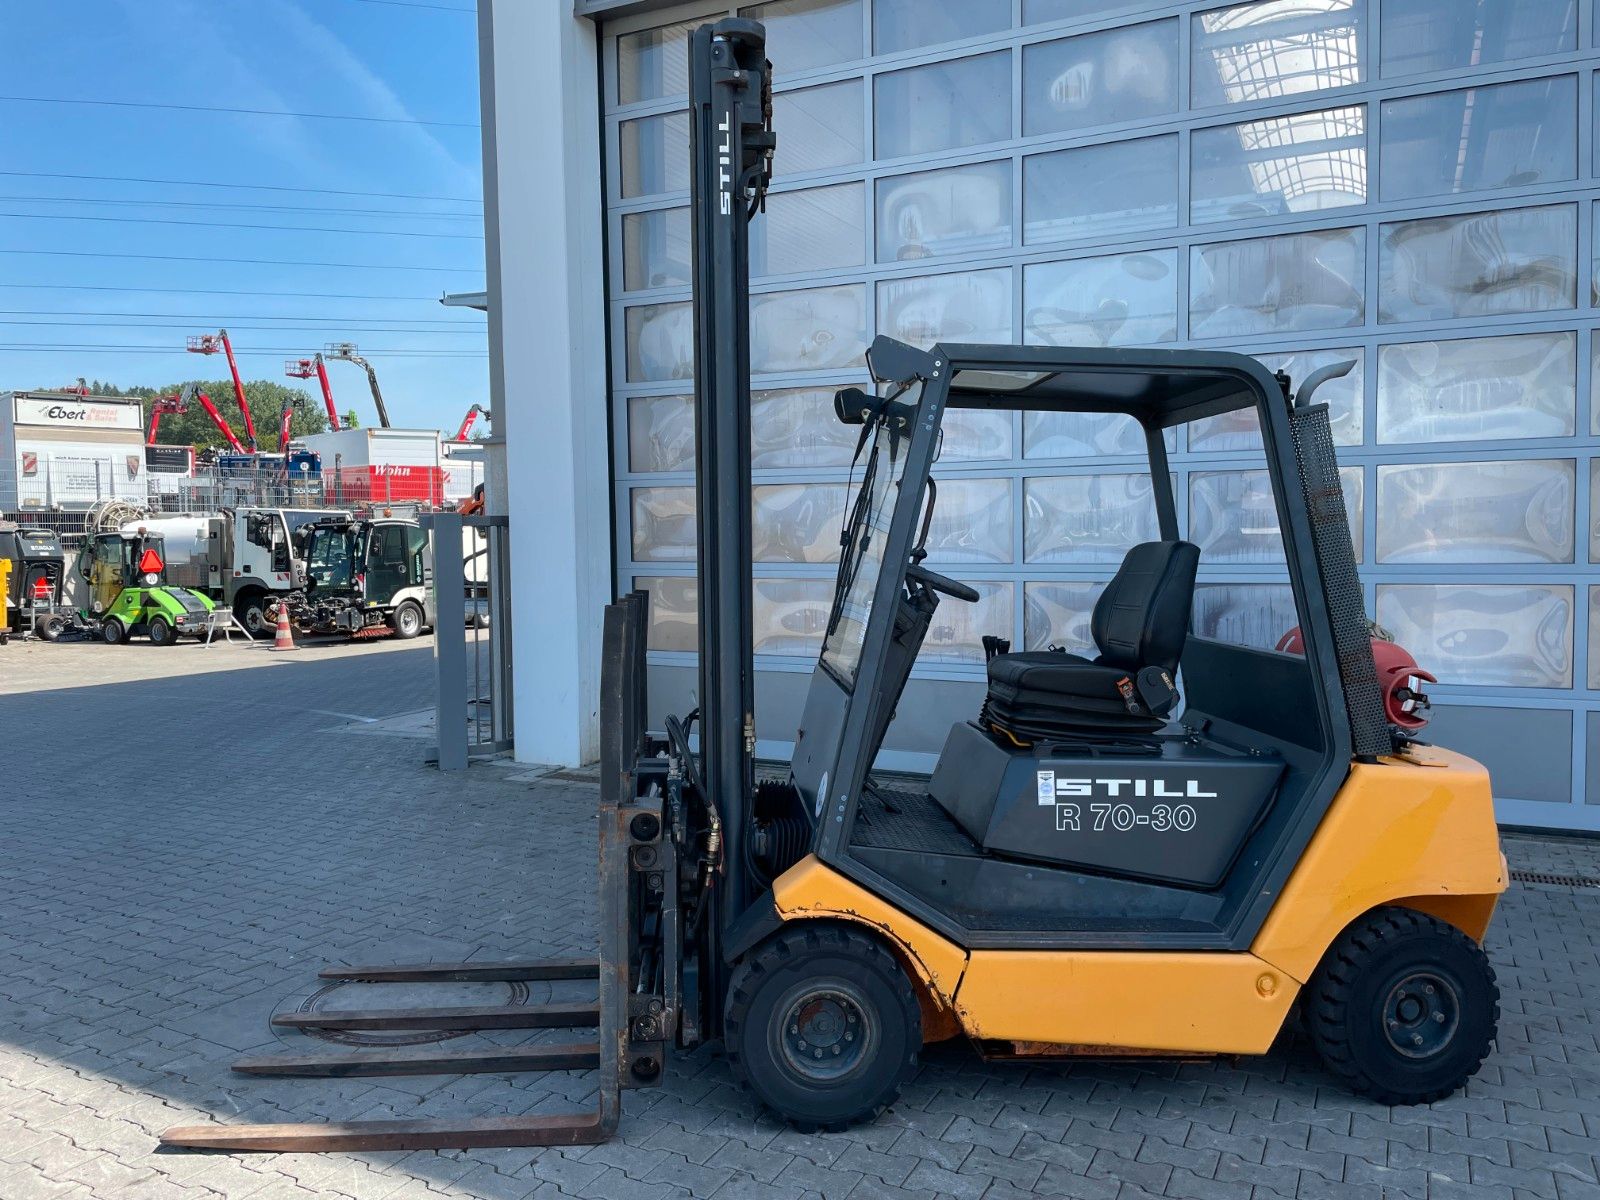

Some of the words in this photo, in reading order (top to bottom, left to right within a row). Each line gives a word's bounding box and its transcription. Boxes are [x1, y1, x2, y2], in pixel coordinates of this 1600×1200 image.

[718, 111, 731, 215] STILL
[48, 406, 86, 420] Ebert
[375, 464, 411, 476] Wohn
[1056, 778, 1218, 798] STILL
[1056, 803, 1081, 831] R
[1090, 803, 1197, 831] 70-30
